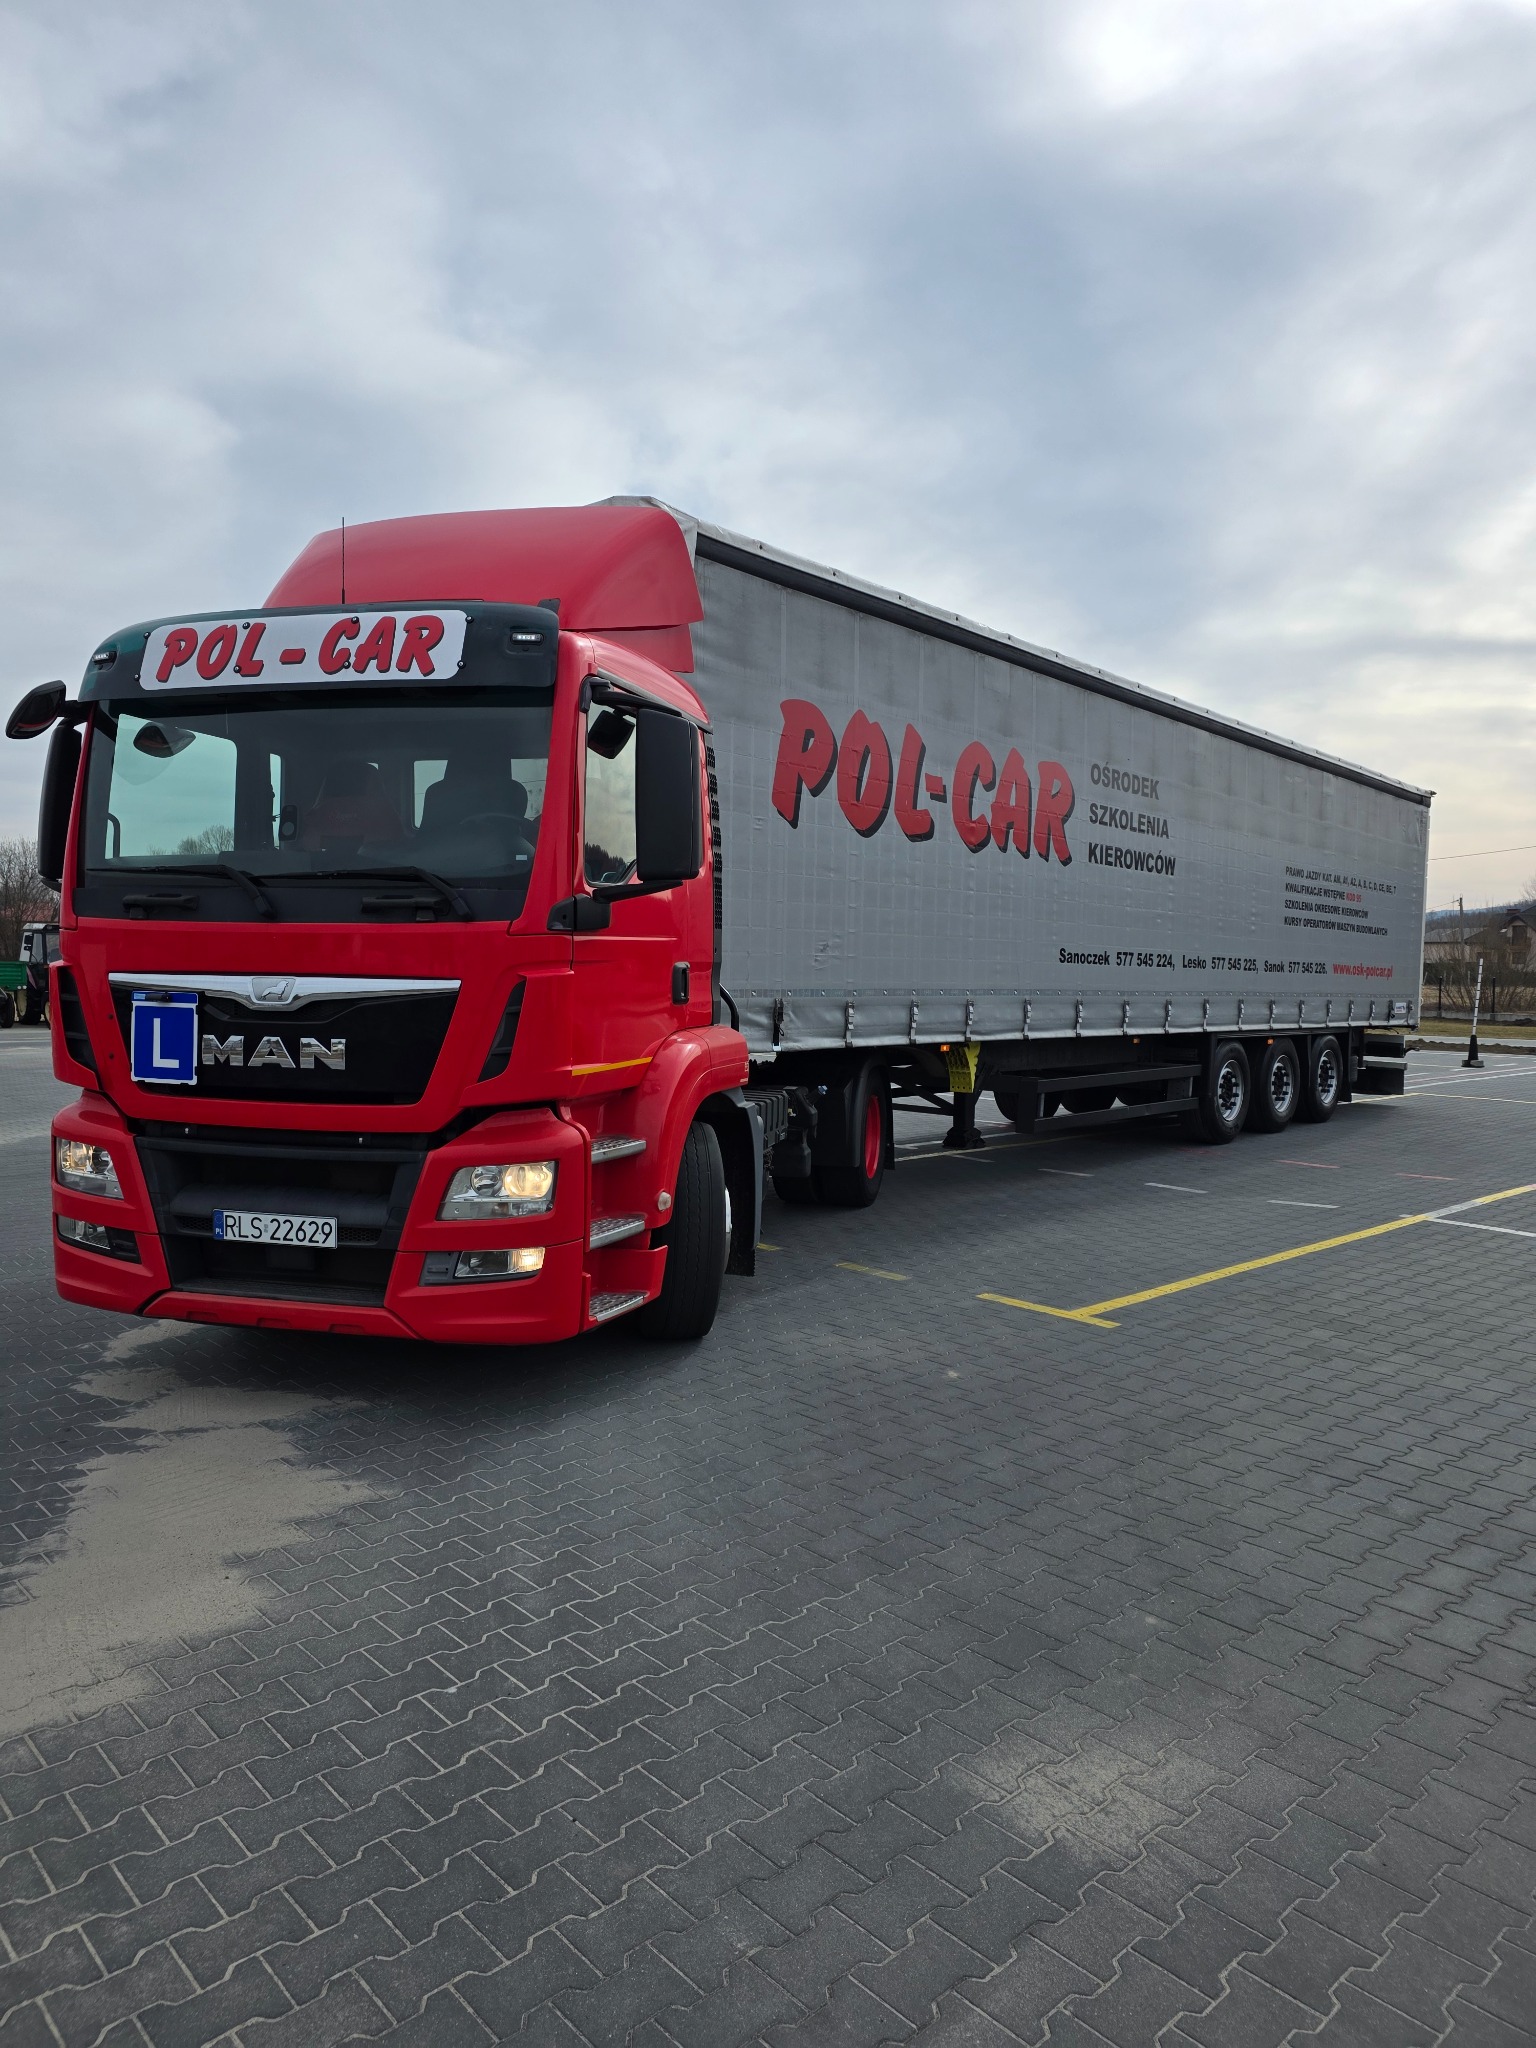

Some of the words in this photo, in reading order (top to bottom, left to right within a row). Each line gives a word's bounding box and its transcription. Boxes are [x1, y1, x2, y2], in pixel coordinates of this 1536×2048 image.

[155, 622, 266, 683] POL
[318, 616, 444, 677] CAR
[771, 698, 1075, 867] POL-CAR
[1090, 762, 1160, 800] OŚRODEK
[1089, 803, 1169, 839] SZKOLENIA
[1088, 842, 1176, 876] KIEROWCÓW
[1285, 866, 1304, 878] PRAWO
[1305, 870, 1321, 880] JAZDY
[1285, 883, 1322, 896] KWALIFIKACJE
[1323, 888, 1345, 901] WSTĘPNE
[1285, 899, 1313, 912] SZKOLENIA
[1314, 903, 1340, 915] OKRESOWE
[1341, 906, 1369, 919] KIEROWCÓW
[1284, 916, 1302, 926] KURSY
[1303, 918, 1336, 930] OPERATORÓW
[1337, 921, 1355, 932] MASZYN
[1356, 924, 1388, 936] BUDOWLANYCH
[1059, 948, 1110, 965] Sanoczek
[1116, 952, 1134, 966] 577
[1137, 953, 1154, 967] 545
[1156, 954, 1175, 971] 224,
[1182, 955, 1206, 969] Lesko
[1211, 957, 1226, 970] 577
[1227, 958, 1241, 970] 545
[1243, 959, 1258, 974] 225,
[1264, 960, 1285, 973] Sanok
[1288, 962, 1300, 973] 577
[1301, 962, 1313, 974] 545
[1332, 963, 1393, 981] www.osk-polcar.pl
[153, 1018, 179, 1068] L
[202, 1034, 347, 1070] MAN
[215, 1227, 223, 1235] PL
[225, 1215, 262, 1239] RLS
[269, 1218, 333, 1244] 22629
